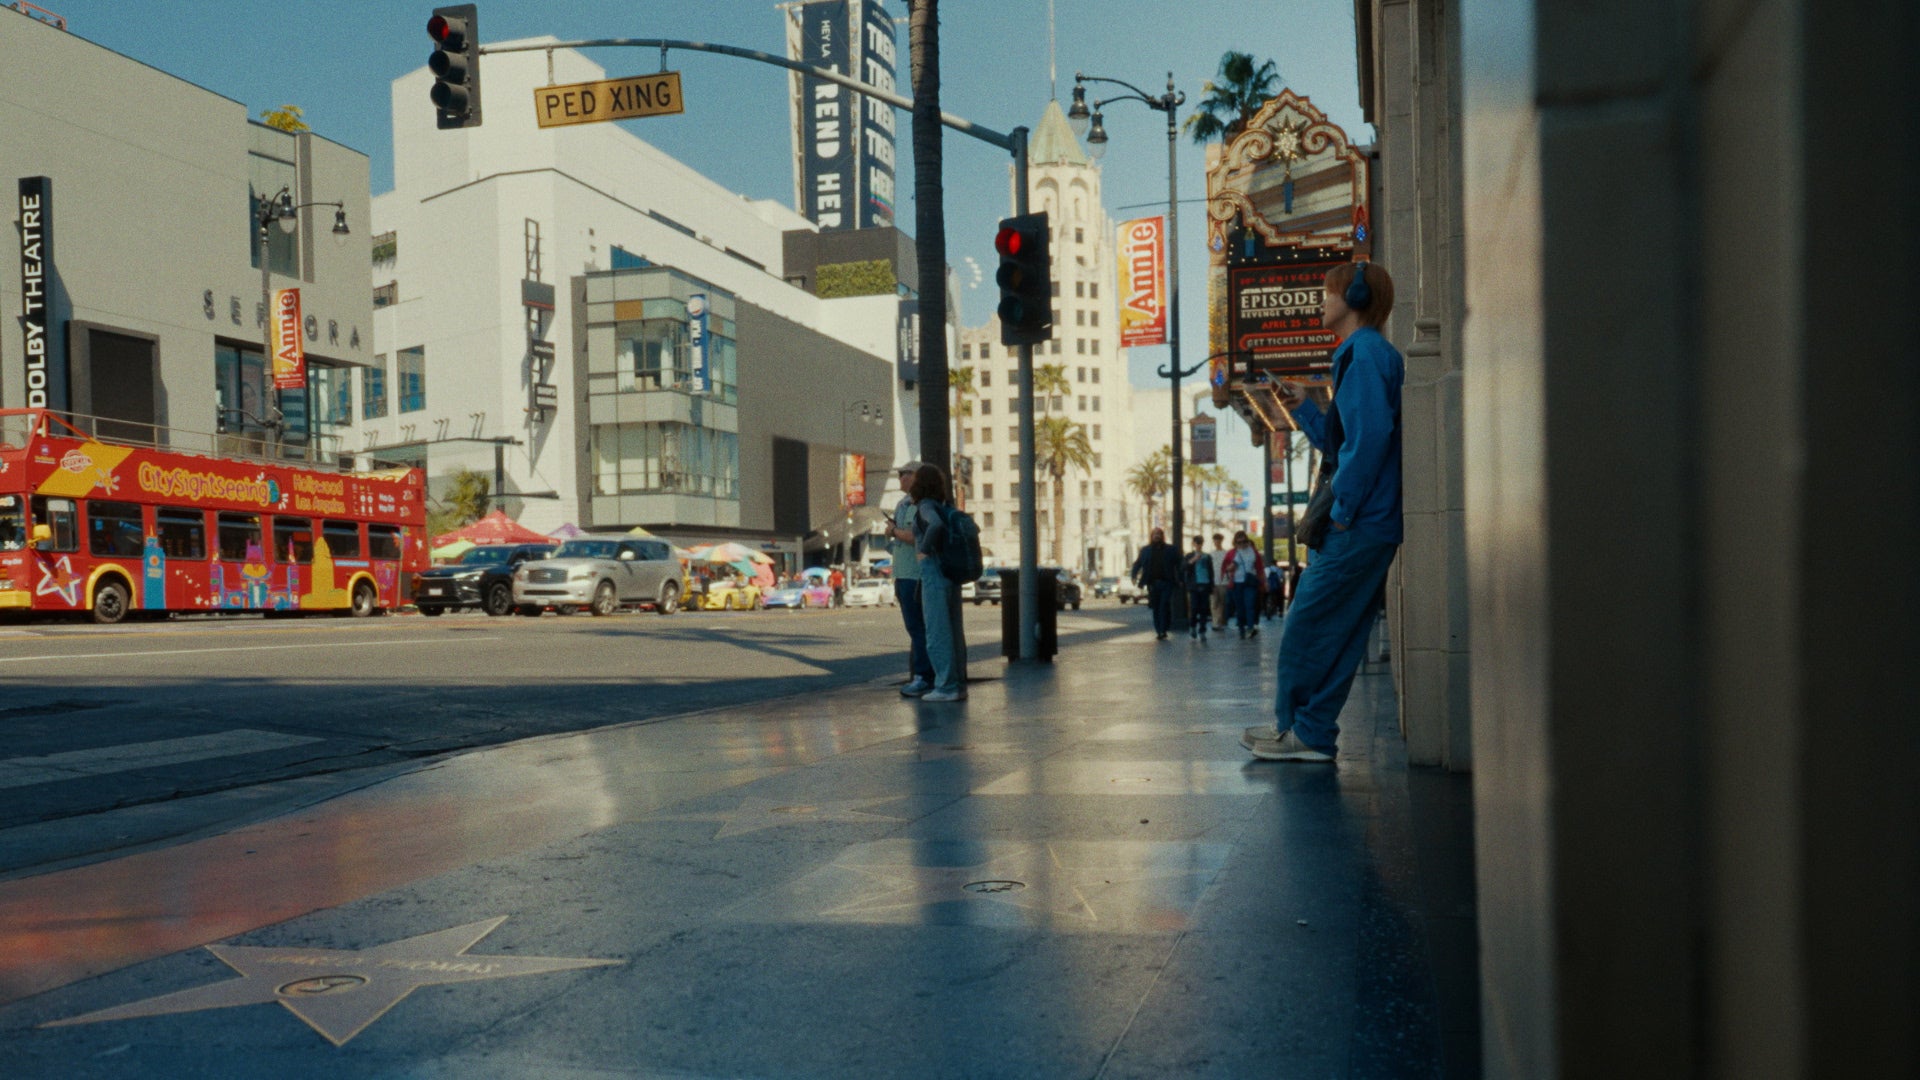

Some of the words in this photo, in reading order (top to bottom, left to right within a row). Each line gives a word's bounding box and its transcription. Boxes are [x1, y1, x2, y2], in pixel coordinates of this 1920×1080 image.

[822, 20, 831, 41] HEY
[822, 43, 832, 58] LA
[546, 90, 596, 119] PED
[610, 81, 671, 112] XING
[817, 173, 841, 229] HER
[22, 194, 44, 315] THEATRE
[1124, 221, 1158, 318] Annie
[1260, 273, 1326, 282] ANNIVERSA
[1241, 291, 1317, 309] EPISODE
[203, 289, 361, 351] SEPORA
[1241, 310, 1280, 318] REVENGE
[1262, 320, 1287, 330] APRIL
[276, 291, 300, 366] Annie
[1247, 338, 1265, 348] GET
[1268, 336, 1305, 345] TICKETS
[1308, 334, 1335, 343] NOW!
[26, 321, 47, 414] DOLBY
[138, 461, 270, 507] CitySightseeing
[293, 473, 344, 496] Hollywood
[295, 493, 312, 511] Los
[312, 495, 346, 514] Angeles
